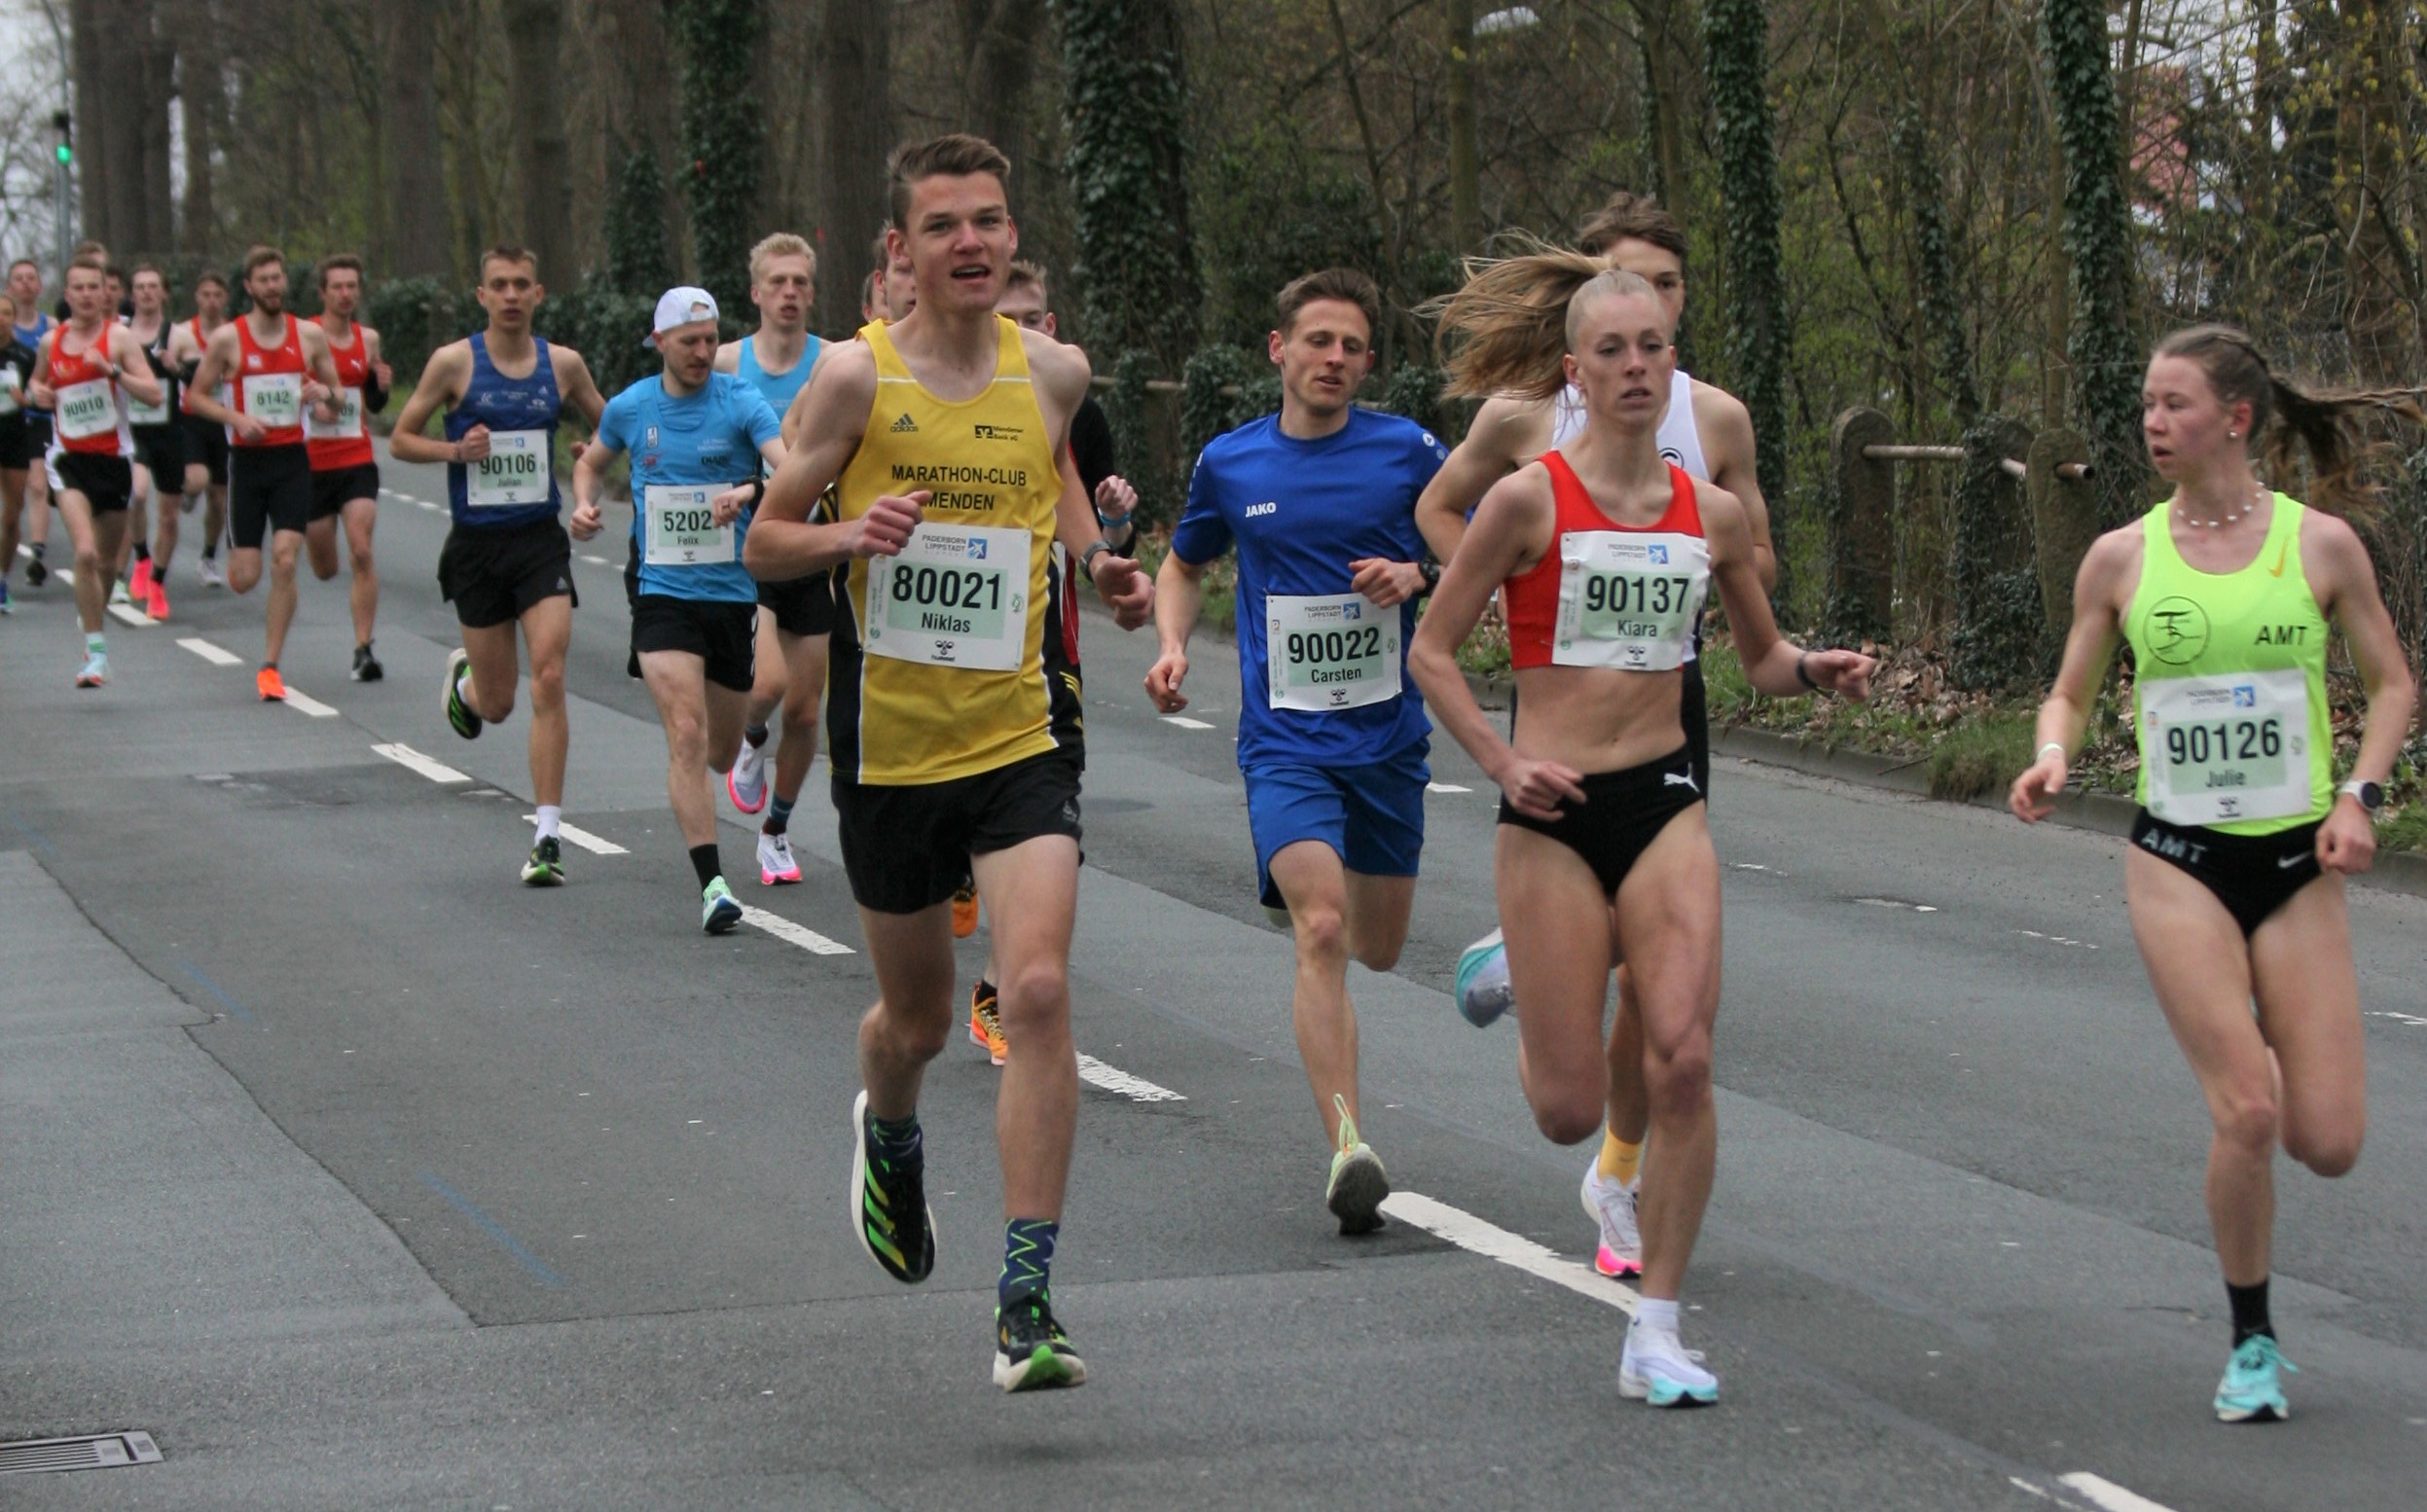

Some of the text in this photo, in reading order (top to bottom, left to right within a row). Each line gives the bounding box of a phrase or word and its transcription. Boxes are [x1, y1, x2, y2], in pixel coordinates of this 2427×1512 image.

[256, 391, 290, 406] 6142
[889, 424, 920, 433] adidas
[480, 453, 536, 475] 90106
[497, 478, 523, 487] Julian
[891, 464, 1028, 486] MARATHON-CLUB
[925, 491, 995, 511] MENDEN
[1245, 501, 1277, 518] JAKO
[664, 510, 712, 532] 5202
[677, 535, 700, 546] Felix
[922, 534, 966, 545] PADERBORN
[924, 543, 965, 553] LIPPSTADT
[891, 564, 1001, 611] 80021
[1586, 574, 1690, 613] 90137
[922, 612, 971, 633] Niklas
[1617, 619, 1657, 637] Kiara
[1287, 627, 1380, 665] 90022
[2255, 626, 2308, 646] AMT
[1311, 666, 1362, 683] Carsten
[2167, 719, 2281, 765] 90126
[2205, 769, 2246, 788] Julie
[2141, 828, 2207, 864] AMT
